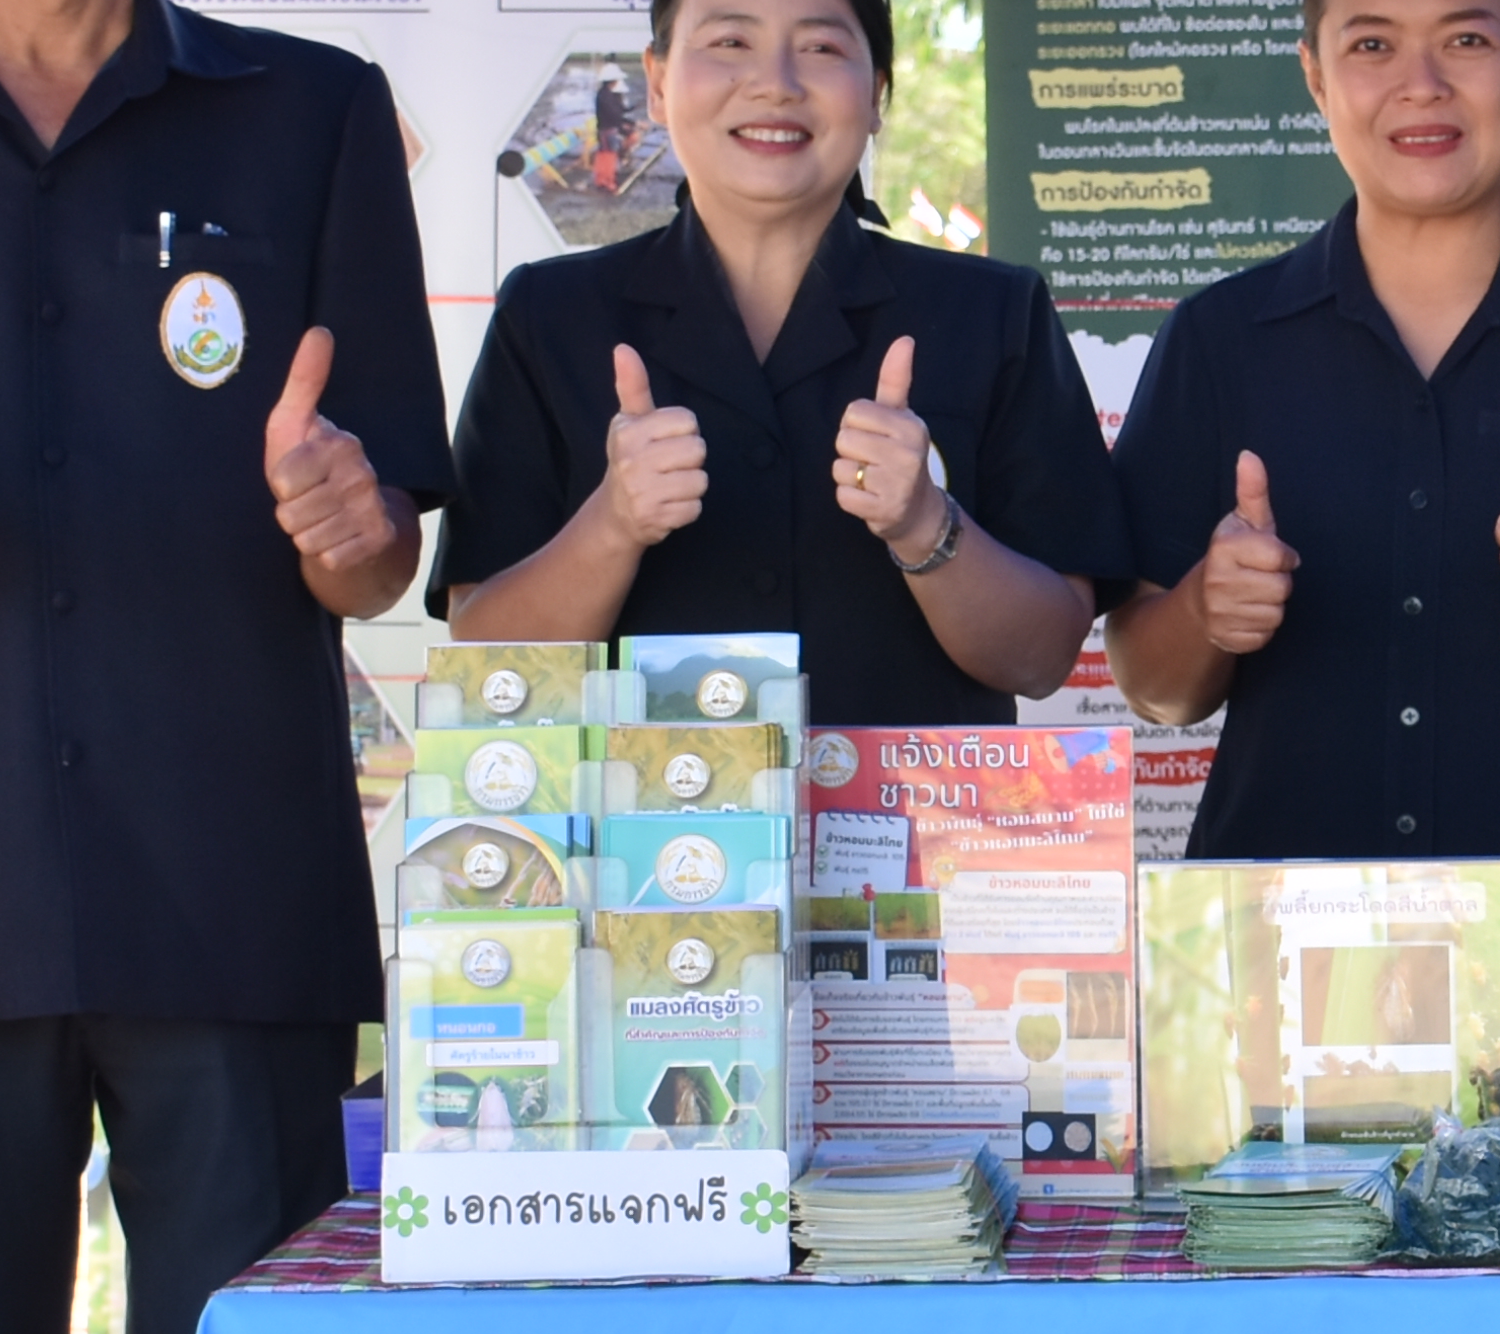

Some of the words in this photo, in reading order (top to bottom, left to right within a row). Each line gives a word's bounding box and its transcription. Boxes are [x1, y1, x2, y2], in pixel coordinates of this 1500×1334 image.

[880, 733, 1030, 769] แจ้งเตือน
[880, 781, 978, 808] ชาวนา
[628, 991, 763, 1023] แมลงศัตรูข้าว
[442, 1176, 730, 1230] เอกสารแจกฟรี
